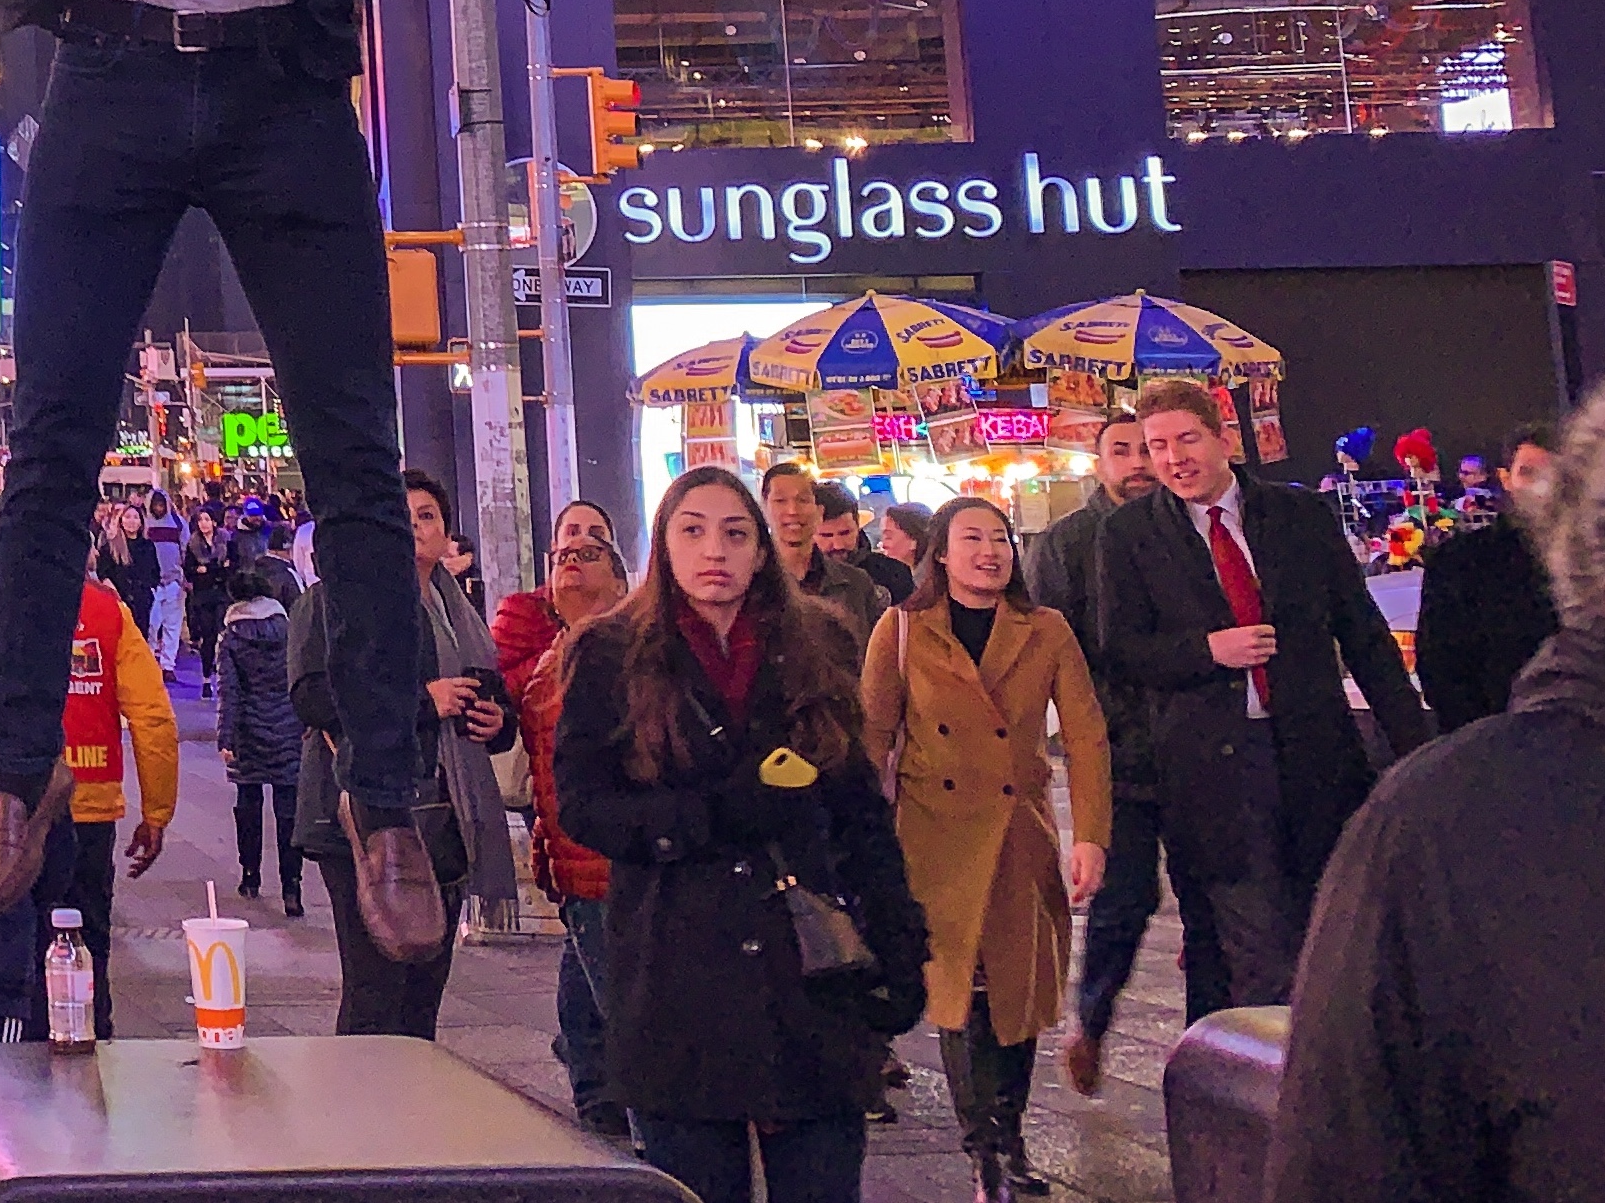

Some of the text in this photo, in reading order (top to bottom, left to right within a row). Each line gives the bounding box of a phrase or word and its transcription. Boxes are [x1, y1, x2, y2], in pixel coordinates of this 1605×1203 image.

[618, 152, 1182, 264] sunglass hut
[896, 318, 945, 344] SABRETT
[906, 355, 992, 383] SABRETT
[65, 745, 108, 768] LINE
